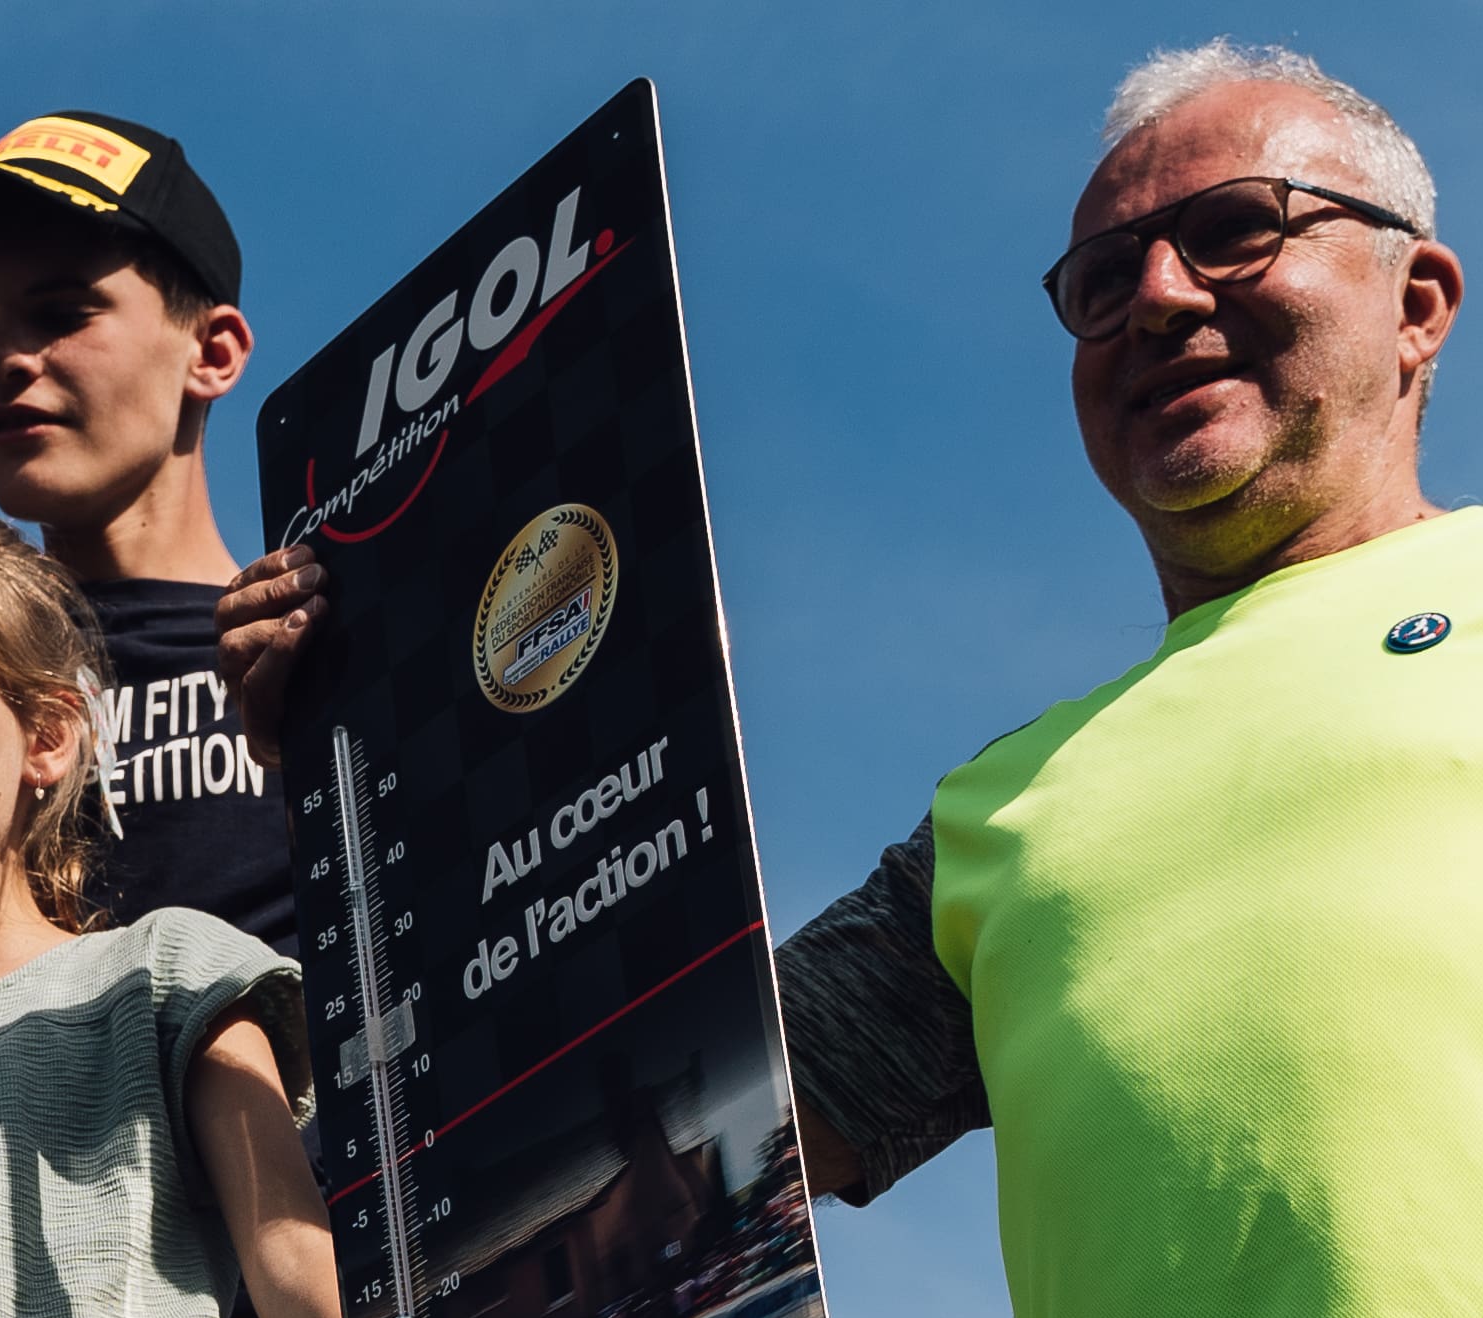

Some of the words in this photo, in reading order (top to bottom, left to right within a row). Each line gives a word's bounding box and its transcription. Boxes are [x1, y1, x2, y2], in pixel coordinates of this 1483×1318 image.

[281, 394, 459, 549] Compétition
[490, 591, 545, 636] FÉDÉRATION
[491, 632, 506, 649] DU
[507, 610, 536, 640] SPORT
[518, 595, 580, 660] FFSA
[539, 615, 590, 661] RALLYE
[145, 670, 228, 740] FITY
[109, 733, 264, 804] ETITION
[378, 772, 397, 798] 50
[303, 789, 323, 815] 55
[482, 827, 540, 905] Au
[549, 736, 669, 850] cœur
[386, 841, 405, 865] 40
[310, 857, 330, 881] 45
[463, 921, 518, 1000] de
[695, 787, 715, 842] !
[394, 911, 413, 937] 30
[317, 925, 337, 951] 35
[402, 982, 422, 1004] 20
[325, 995, 346, 1021] 25
[334, 1065, 354, 1090] 15
[411, 1053, 431, 1079] 10
[347, 1139, 357, 1159] 5
[424, 1129, 435, 1148] 0
[352, 1208, 368, 1230] -5
[426, 1197, 451, 1225] -10
[355, 1279, 383, 1304] -15
[435, 1271, 461, 1298] -20
